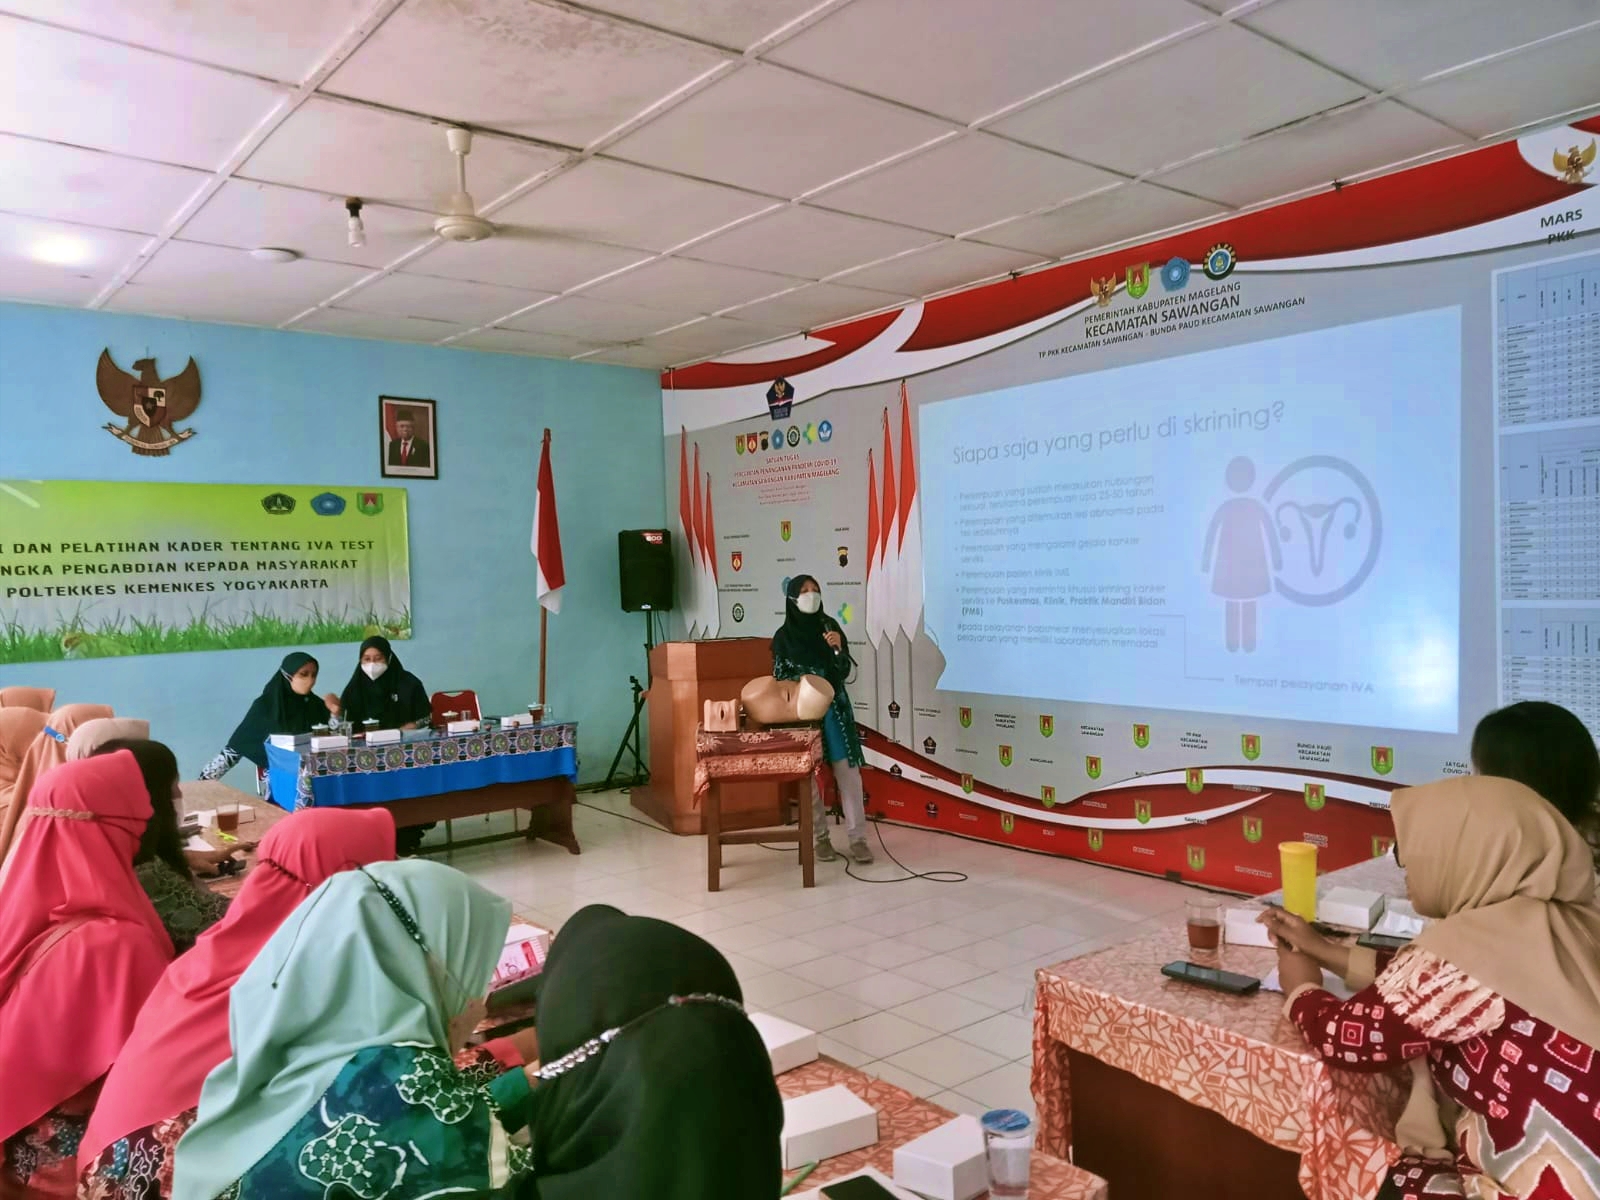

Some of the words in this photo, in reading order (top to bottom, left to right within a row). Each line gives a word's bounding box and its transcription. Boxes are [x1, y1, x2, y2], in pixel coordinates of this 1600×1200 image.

[1540, 208, 1583, 228] MARS
[1548, 229, 1575, 244] PKK
[1084, 307, 1135, 324] PEMERINTAH
[1137, 294, 1186, 315] KABUPATEN
[1188, 281, 1241, 302] MAGELANG
[1060, 340, 1102, 354] KECAMATAN
[1102, 332, 1144, 346] SAWANGAN
[1150, 325, 1177, 337] BUNDA
[1179, 319, 1200, 331] PAUD
[1202, 308, 1252, 326] KECAMATAN
[1254, 296, 1306, 316] SAWANGAN
[1085, 311, 1158, 339] KECAMATAN
[1161, 294, 1241, 323] SAWANGAN
[953, 443, 999, 466] Siapa
[1003, 436, 1039, 460] saja
[1044, 432, 1093, 456] yang
[1099, 417, 1151, 449] perlu
[1157, 416, 1177, 438] di
[1184, 400, 1286, 435] skrining?
[13, 543, 52, 554] DAN
[61, 541, 160, 553] PELATIHAN
[168, 541, 223, 553] KADER
[231, 541, 301, 552] TENTANG
[307, 541, 334, 551] IVA
[340, 540, 375, 551] TEST
[0, 565, 53, 577] NGKA
[62, 562, 177, 575] PENGABDIAN
[185, 560, 249, 573] KEPADA
[256, 559, 359, 571] MASYARAKAT
[7, 584, 117, 598] POLTEKKES
[124, 581, 216, 595] KEMENKES
[223, 578, 330, 592] YOGYAKARTA
